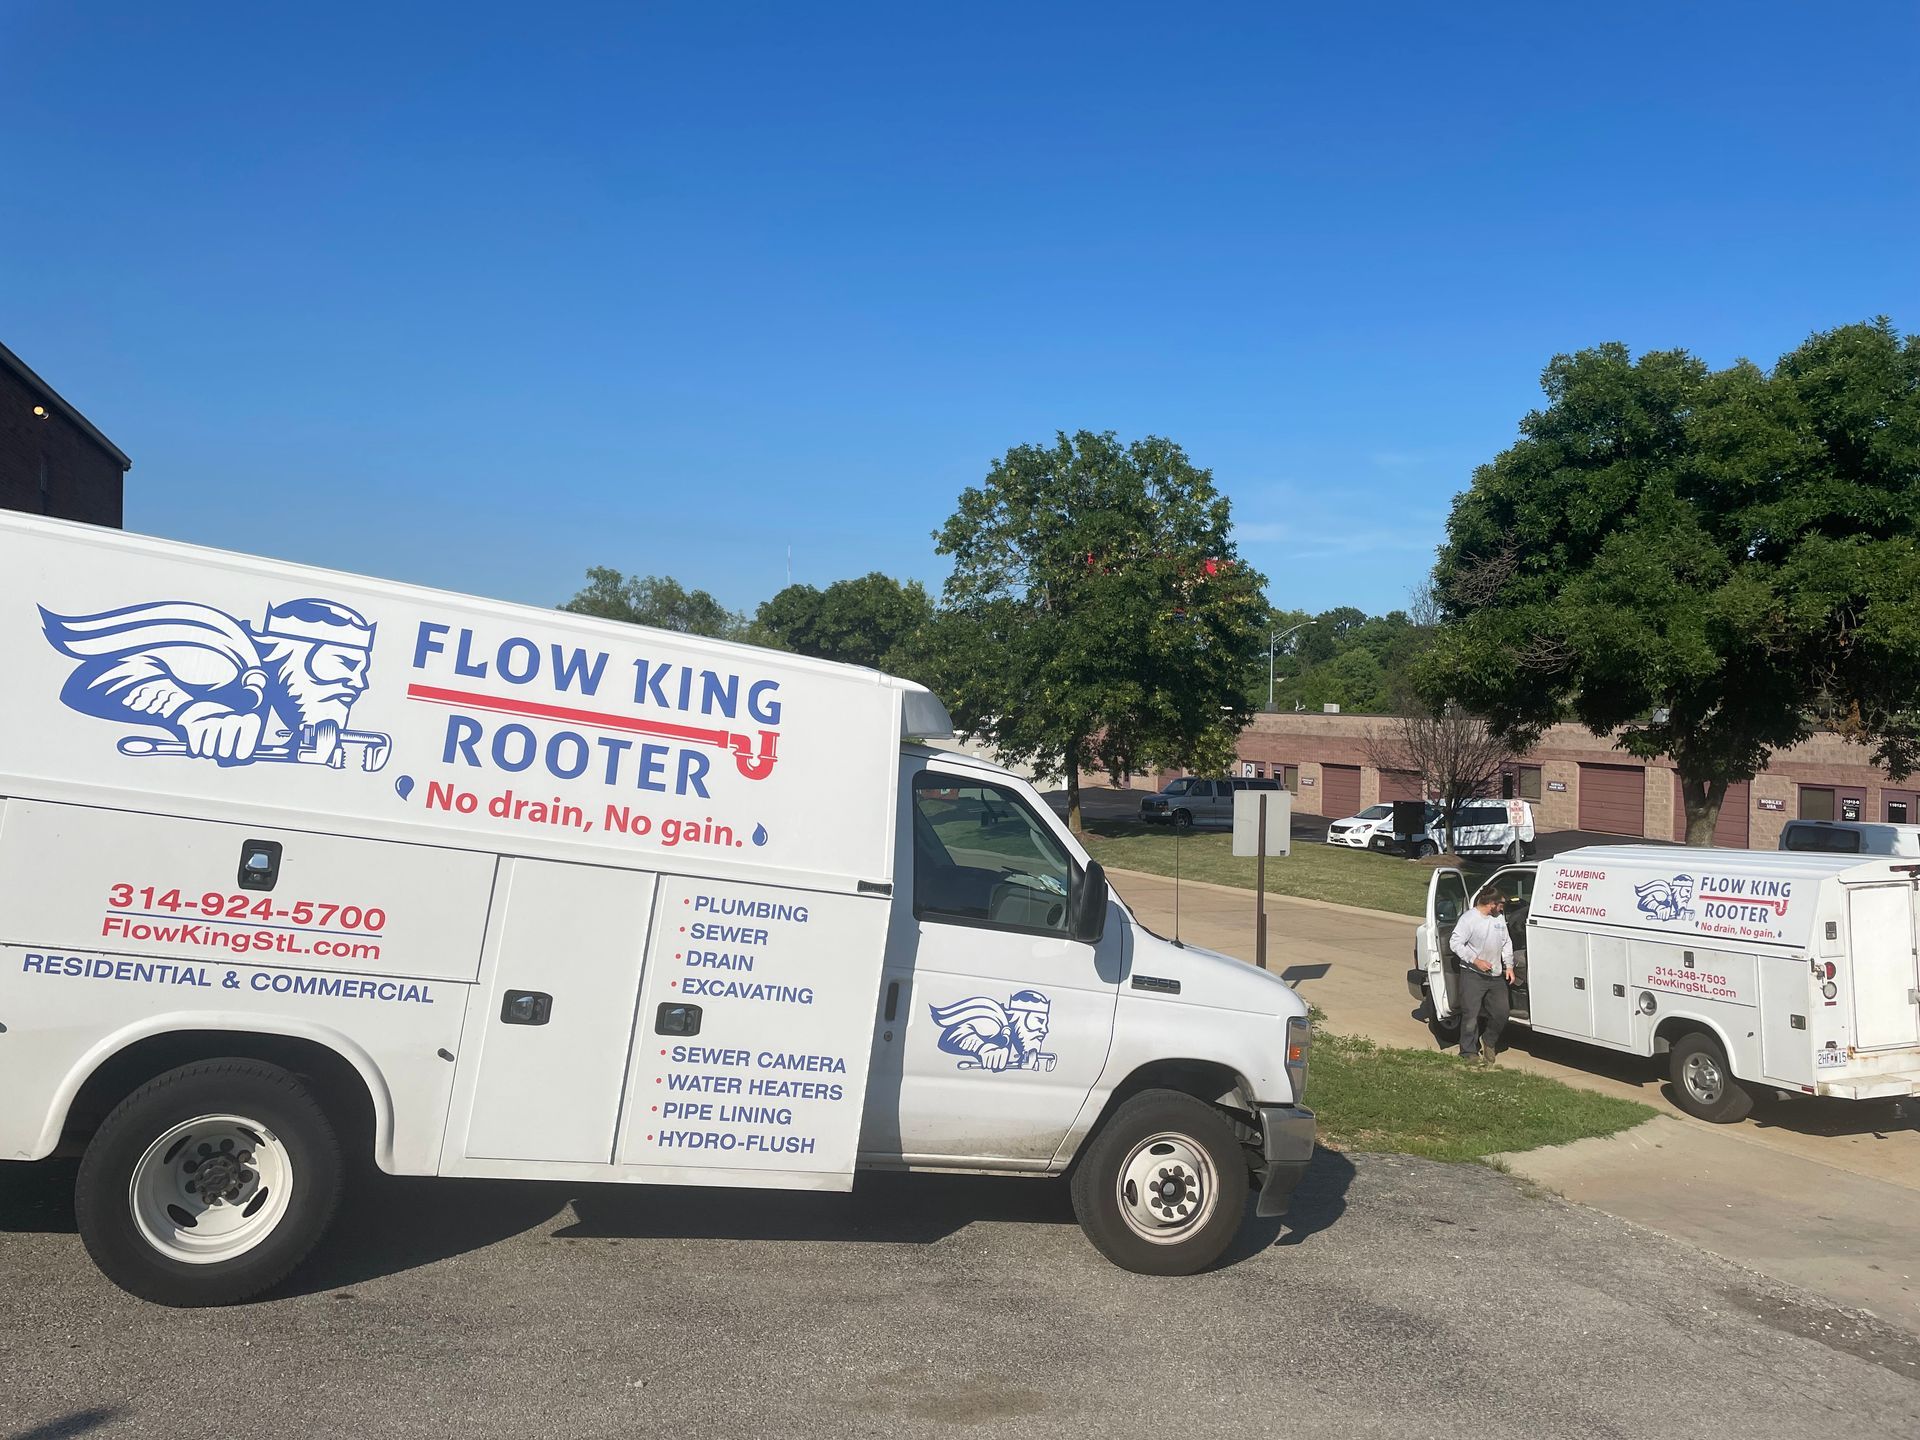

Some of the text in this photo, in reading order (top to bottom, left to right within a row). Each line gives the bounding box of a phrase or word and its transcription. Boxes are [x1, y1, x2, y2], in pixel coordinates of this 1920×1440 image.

[412, 620, 782, 726] FLOW KING
[441, 714, 711, 799] ROOTER
[425, 781, 744, 848] No drain, No gain.
[1557, 880, 1588, 891] SEWER
[1559, 868, 1606, 881] PLUMBING
[1555, 892, 1582, 902] DRAIN
[1700, 876, 1792, 898] FLOW KING
[108, 883, 387, 932] 314-924-5700
[694, 896, 810, 924] PLUMBING
[1552, 903, 1607, 917] EXCAVATING
[1704, 902, 1769, 924] ROOTER
[101, 917, 382, 960] FlowKingStL.com
[690, 923, 769, 946] SEWER
[1700, 921, 1776, 940] No drain, No gain.
[685, 950, 755, 973] DRAIN
[22, 953, 435, 1004] RESIDENTIAL & COMMERCIAL
[1647, 975, 1737, 999] FlowKingStL.com
[1655, 966, 1727, 986] 314-348-7503
[681, 978, 814, 1005] EXCAVATING
[671, 1046, 847, 1074] SEWER CAMERA
[667, 1074, 844, 1101] WATER HEATERS
[662, 1102, 793, 1126] PIPE LINING
[658, 1131, 816, 1154] HYDRO-FLUSH
